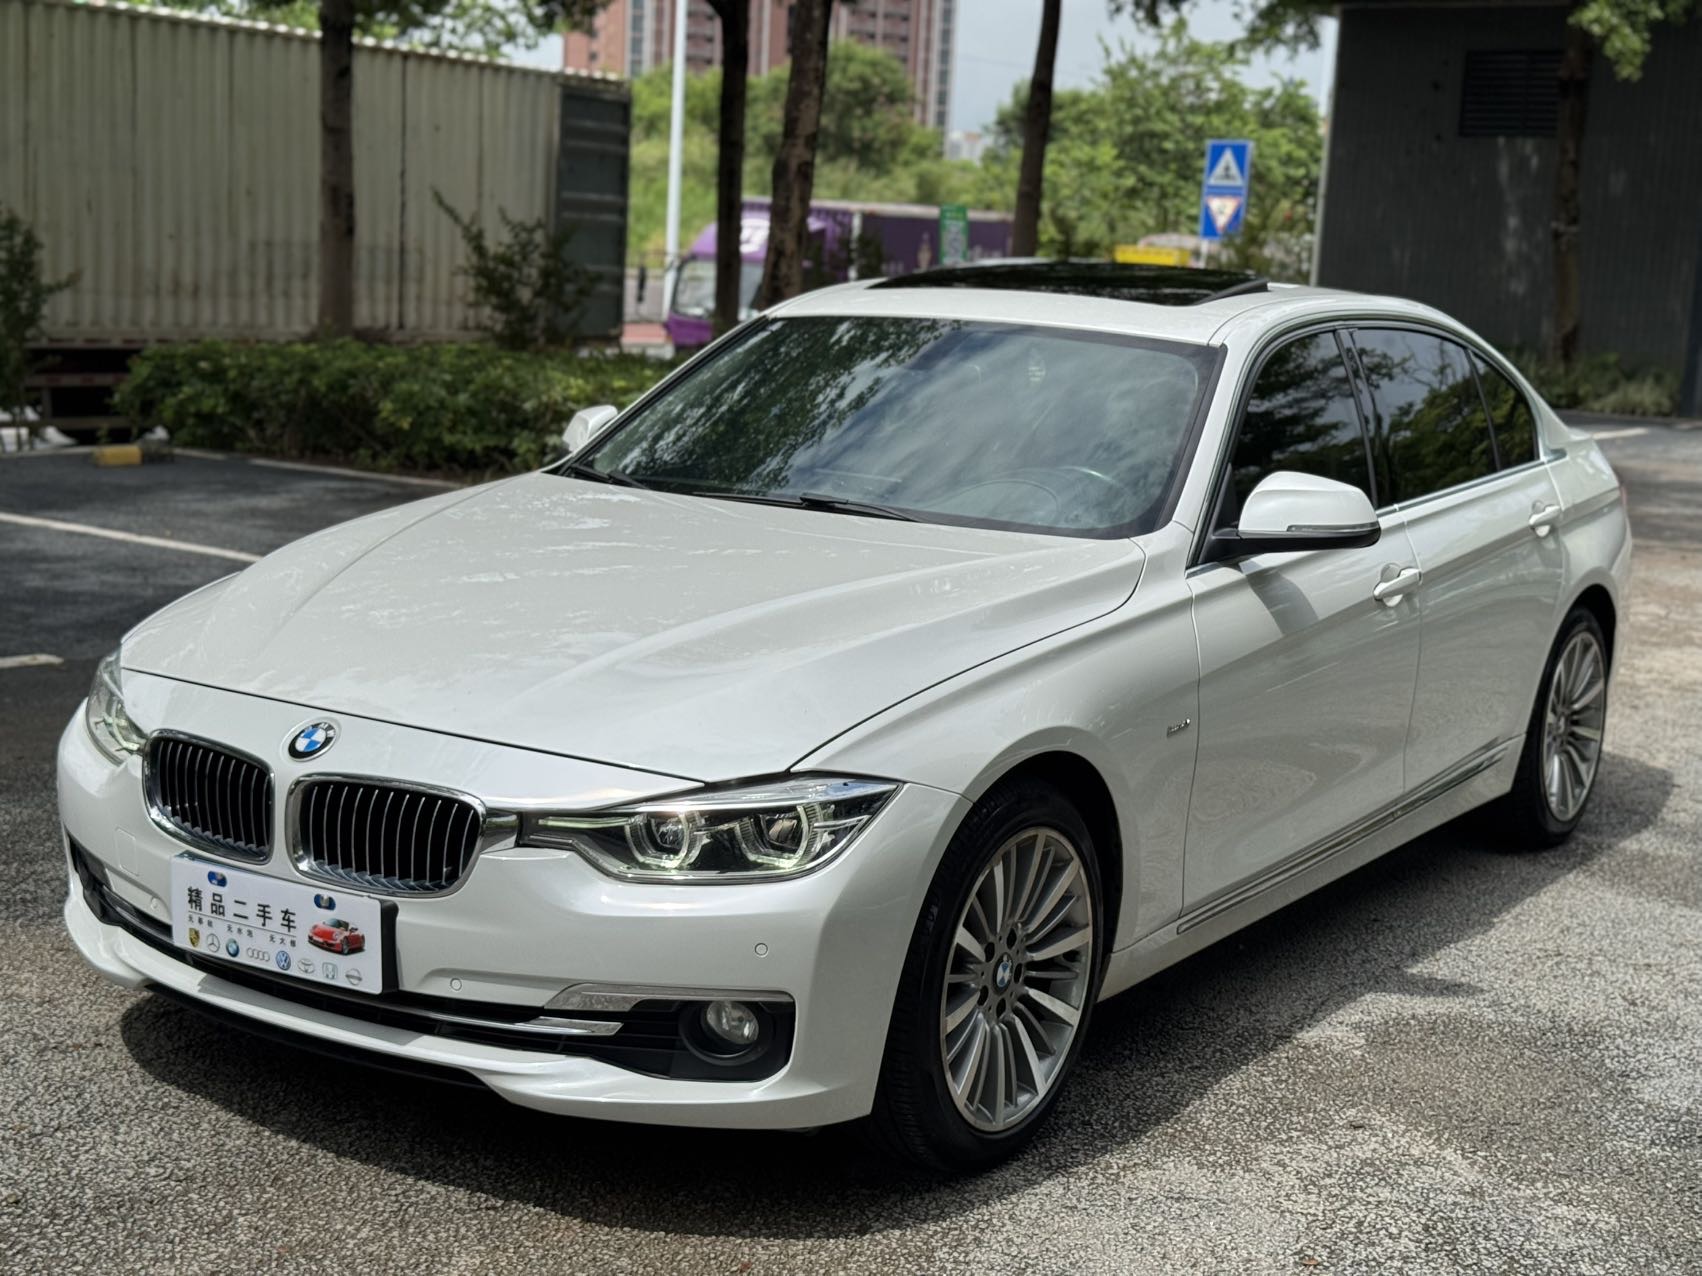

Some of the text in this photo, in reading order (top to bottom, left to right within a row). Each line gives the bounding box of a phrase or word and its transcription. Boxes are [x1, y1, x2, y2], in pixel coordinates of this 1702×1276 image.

[187, 886, 297, 933] 精品二手车
